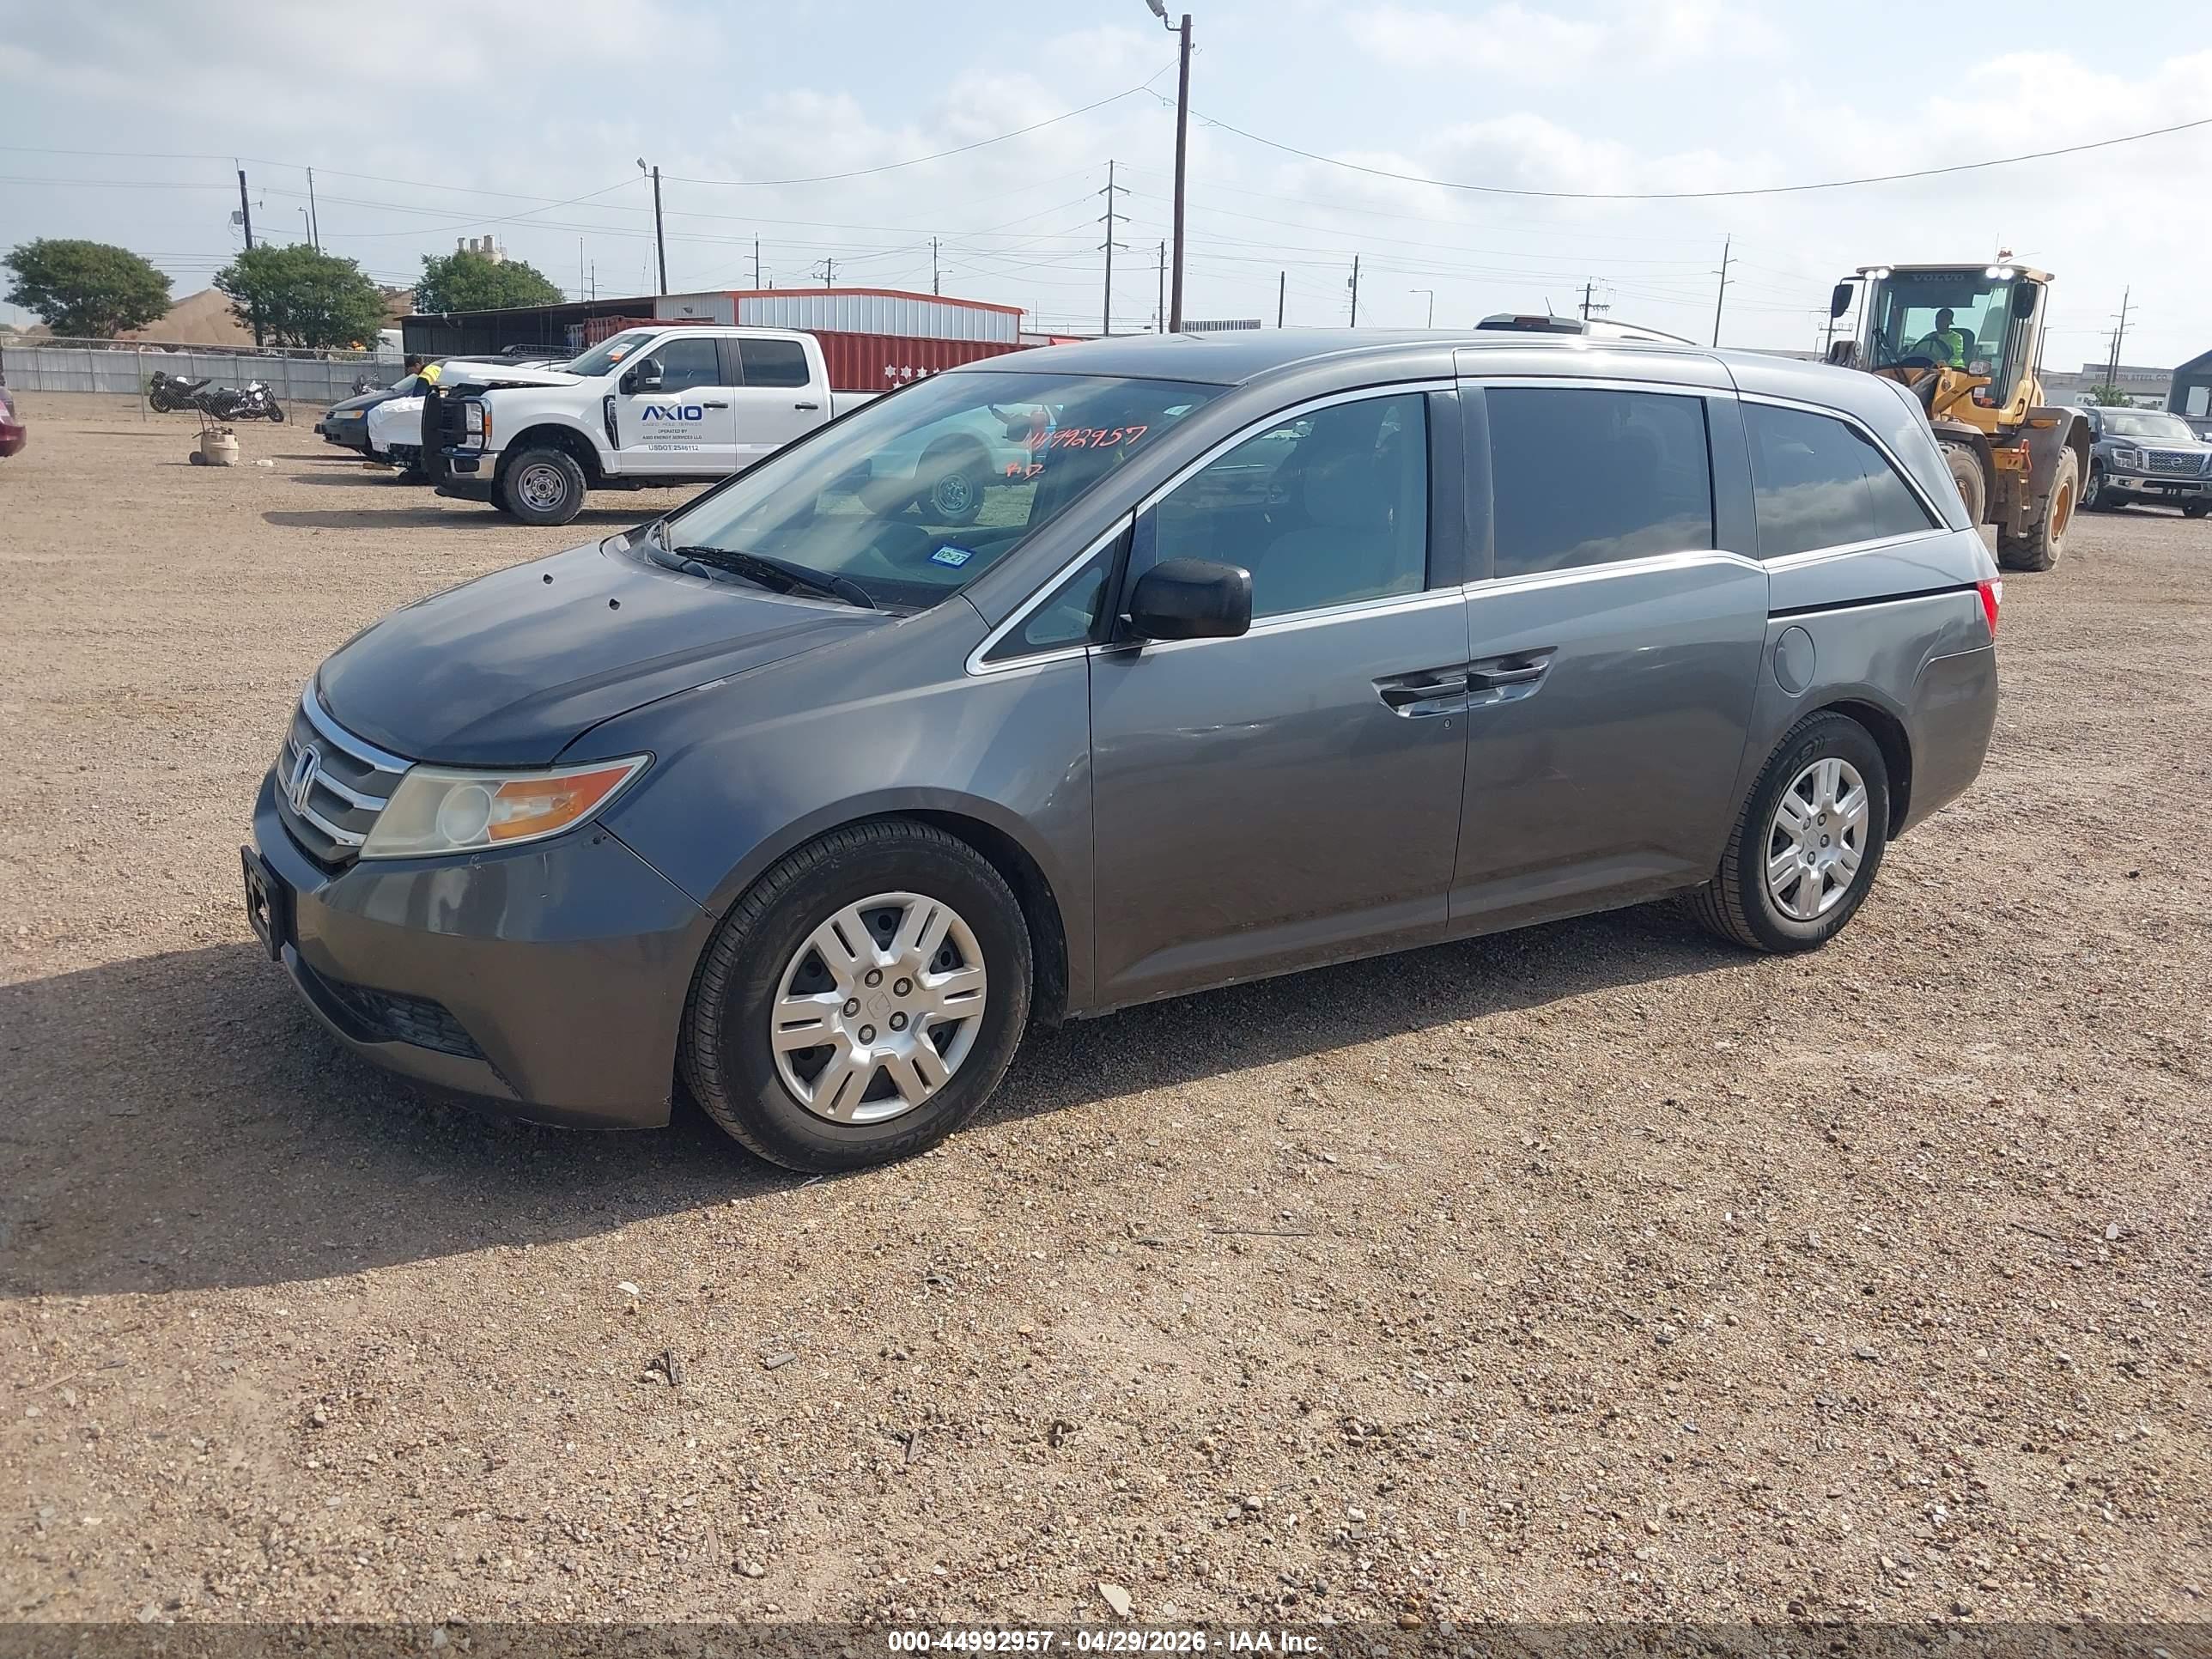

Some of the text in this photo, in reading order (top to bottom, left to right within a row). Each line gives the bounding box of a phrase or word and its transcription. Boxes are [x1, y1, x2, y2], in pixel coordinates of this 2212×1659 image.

[1911, 273, 1966, 283] VOLVO
[2131, 373, 2153, 381] STEEL
[641, 403, 702, 421] AXIO
